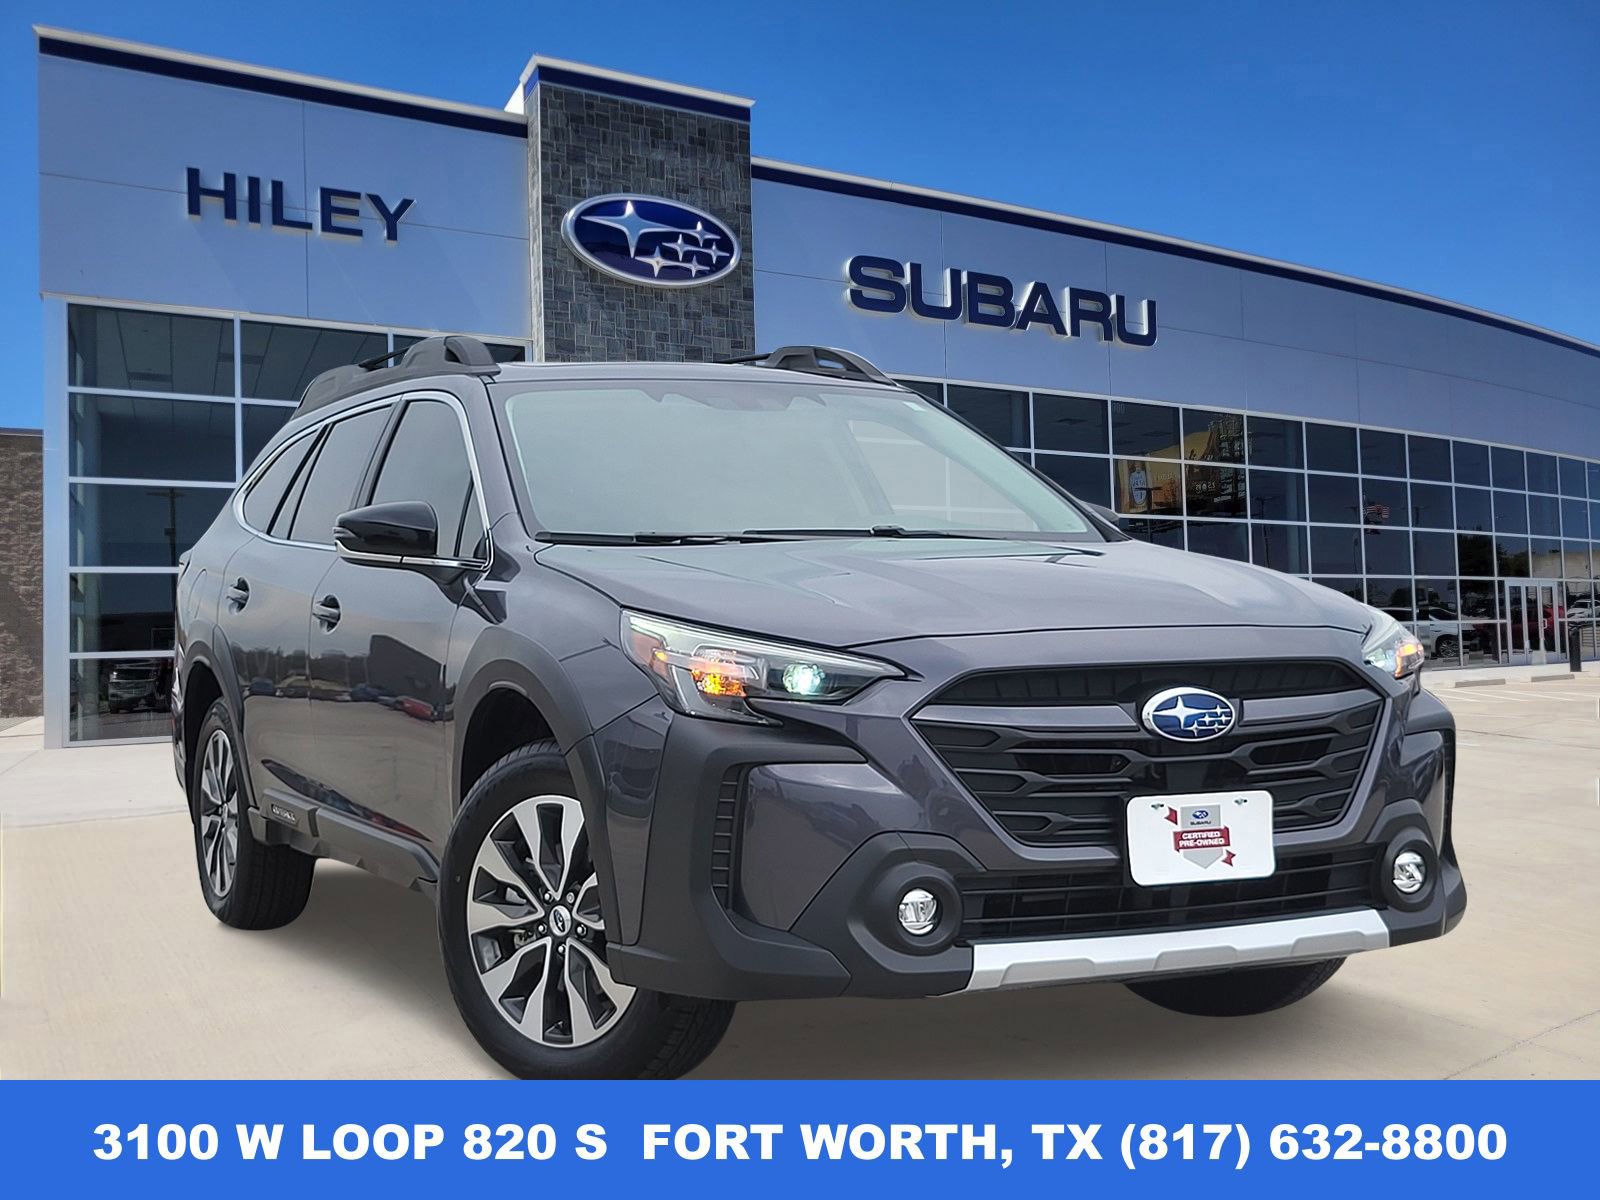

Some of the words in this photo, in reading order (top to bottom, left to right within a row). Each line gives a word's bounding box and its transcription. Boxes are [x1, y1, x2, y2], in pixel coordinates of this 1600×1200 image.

[187, 167, 415, 242] HILEY
[848, 255, 1158, 347] SUBARU
[1178, 838, 1225, 848] PRE-OWNED
[1182, 831, 1220, 840] CERTIFIED
